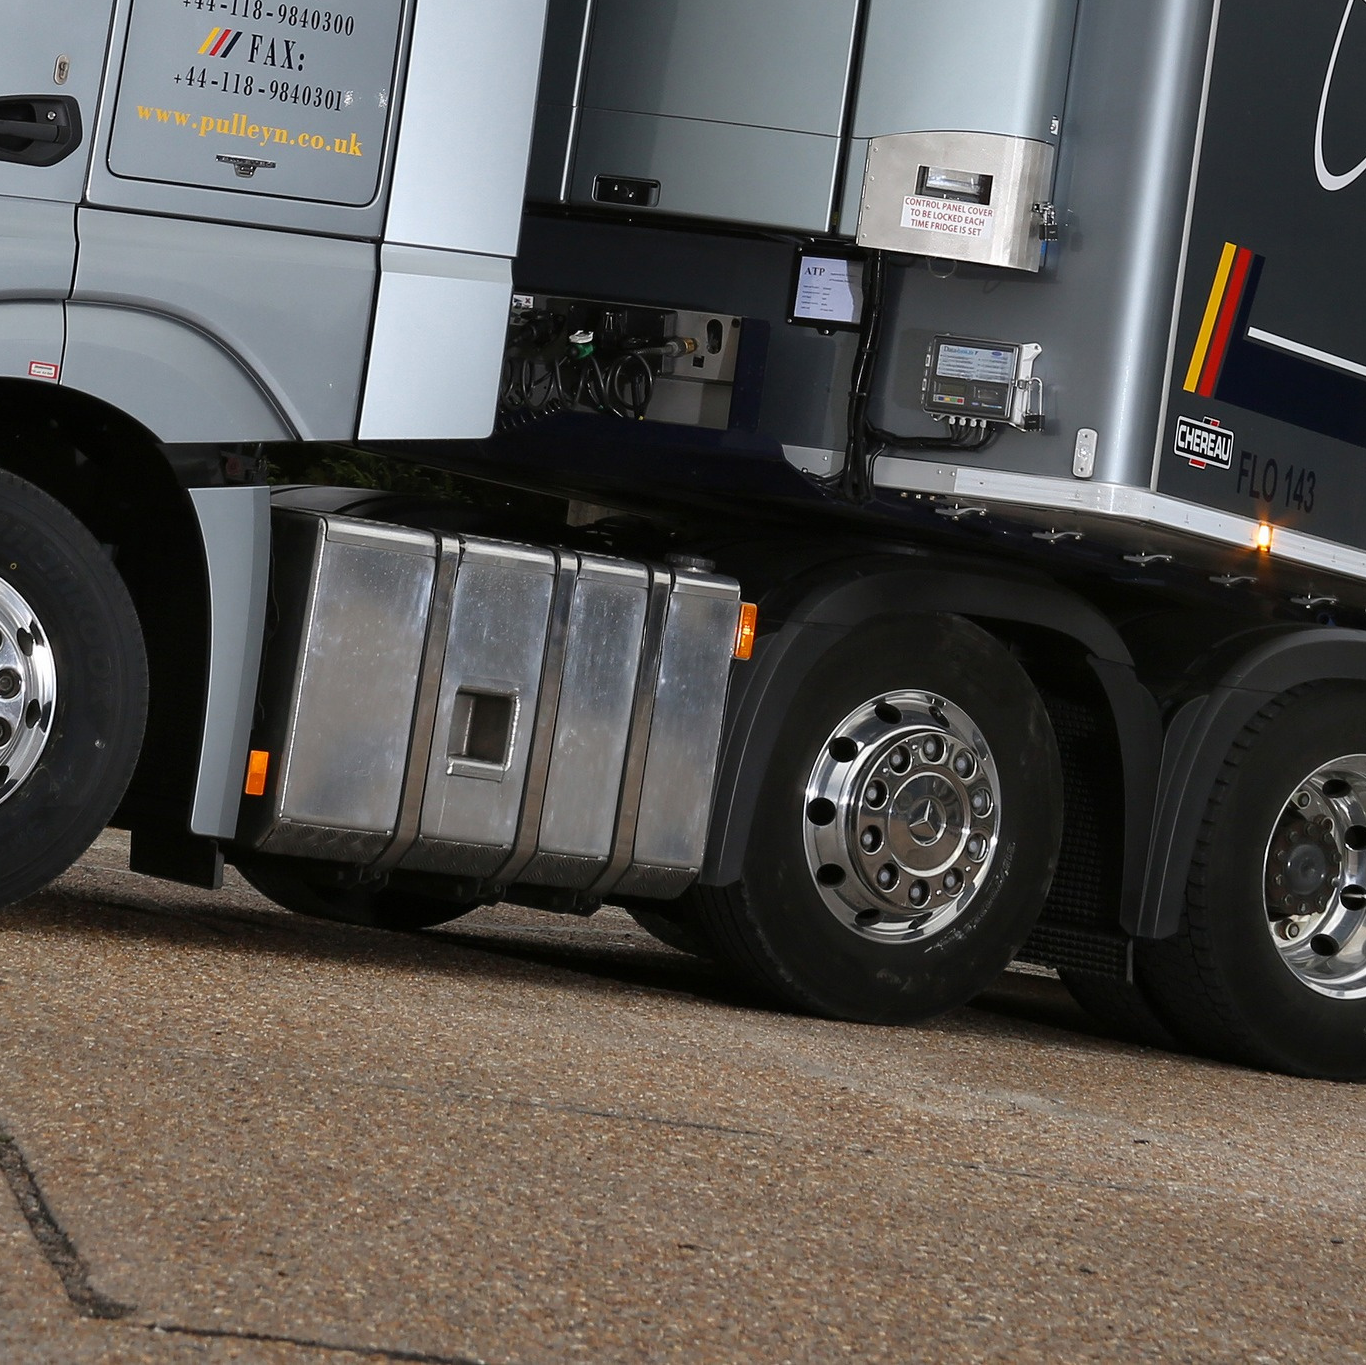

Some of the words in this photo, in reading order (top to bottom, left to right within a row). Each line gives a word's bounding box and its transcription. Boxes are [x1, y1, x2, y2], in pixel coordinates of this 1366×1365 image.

[247, 34, 305, 72] FAX:
[173, 66, 343, 111] +44-118-9840301
[136, 105, 363, 157] www.pulleyn.co.uk
[905, 197, 941, 209] CONTROL
[942, 202, 966, 214] PANEL
[967, 206, 993, 217] COVER
[910, 208, 921, 216] TO
[922, 210, 931, 218] BE
[933, 212, 963, 223] LOCKED
[964, 217, 985, 226] EACH
[911, 218, 929, 228] TIME
[930, 221, 958, 233] FRIDGE
[959, 226, 967, 234] IS
[967, 227, 982, 236] SET
[804, 266, 826, 276] ATP
[1178, 424, 1231, 461] CHEREAU
[1237, 450, 1278, 502] FLO
[1285, 465, 1316, 513] 143
